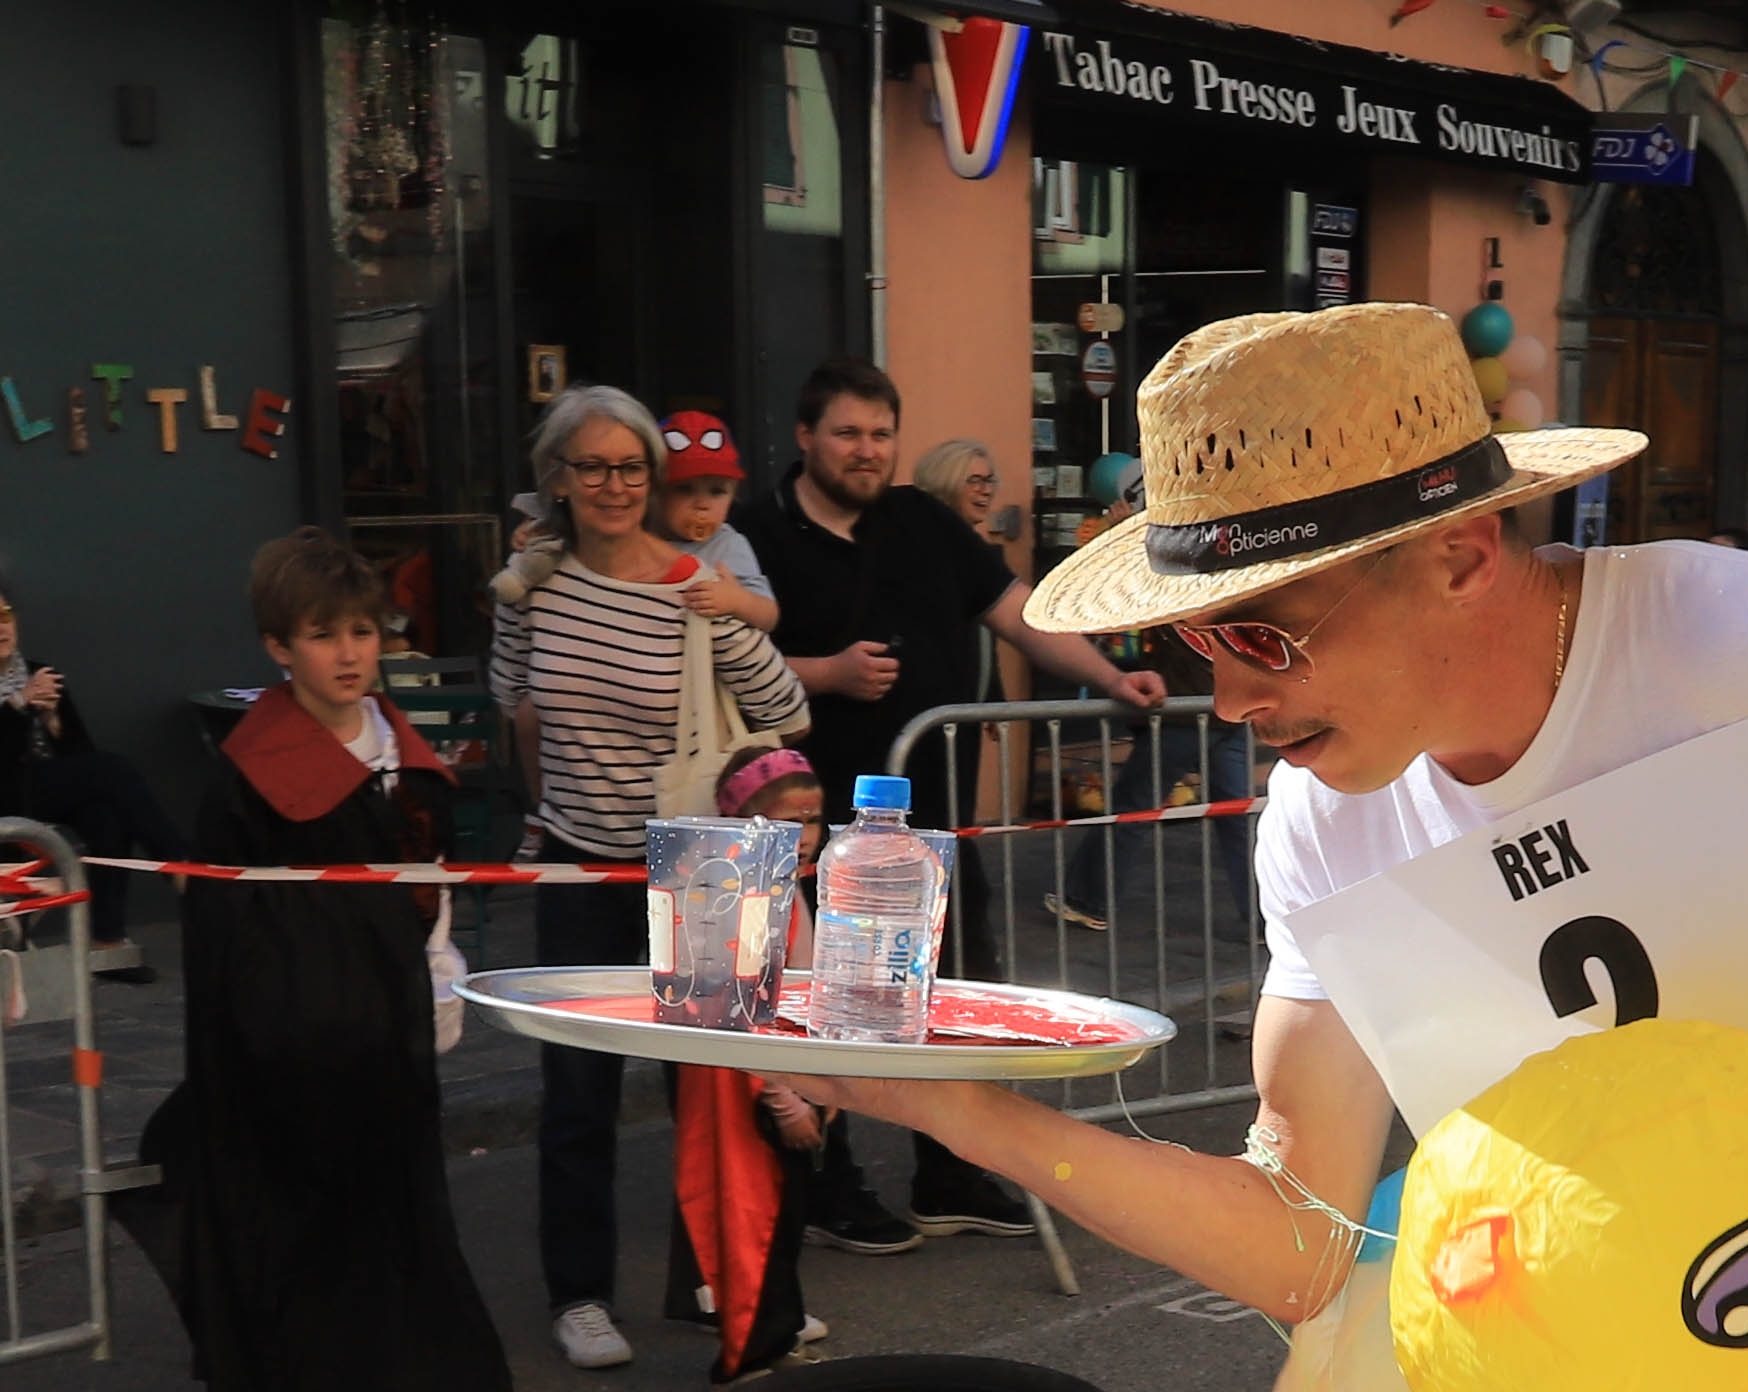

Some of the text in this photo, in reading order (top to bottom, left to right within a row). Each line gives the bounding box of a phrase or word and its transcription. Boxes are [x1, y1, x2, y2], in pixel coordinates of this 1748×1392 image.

[1043, 32, 1581, 172] Tabac Presse Jeux Souvenirs
[1591, 136, 1634, 160] FDJ
[1, 364, 291, 459] LITTLE
[1491, 818, 1592, 902] REX
[887, 929, 912, 984] zilia
